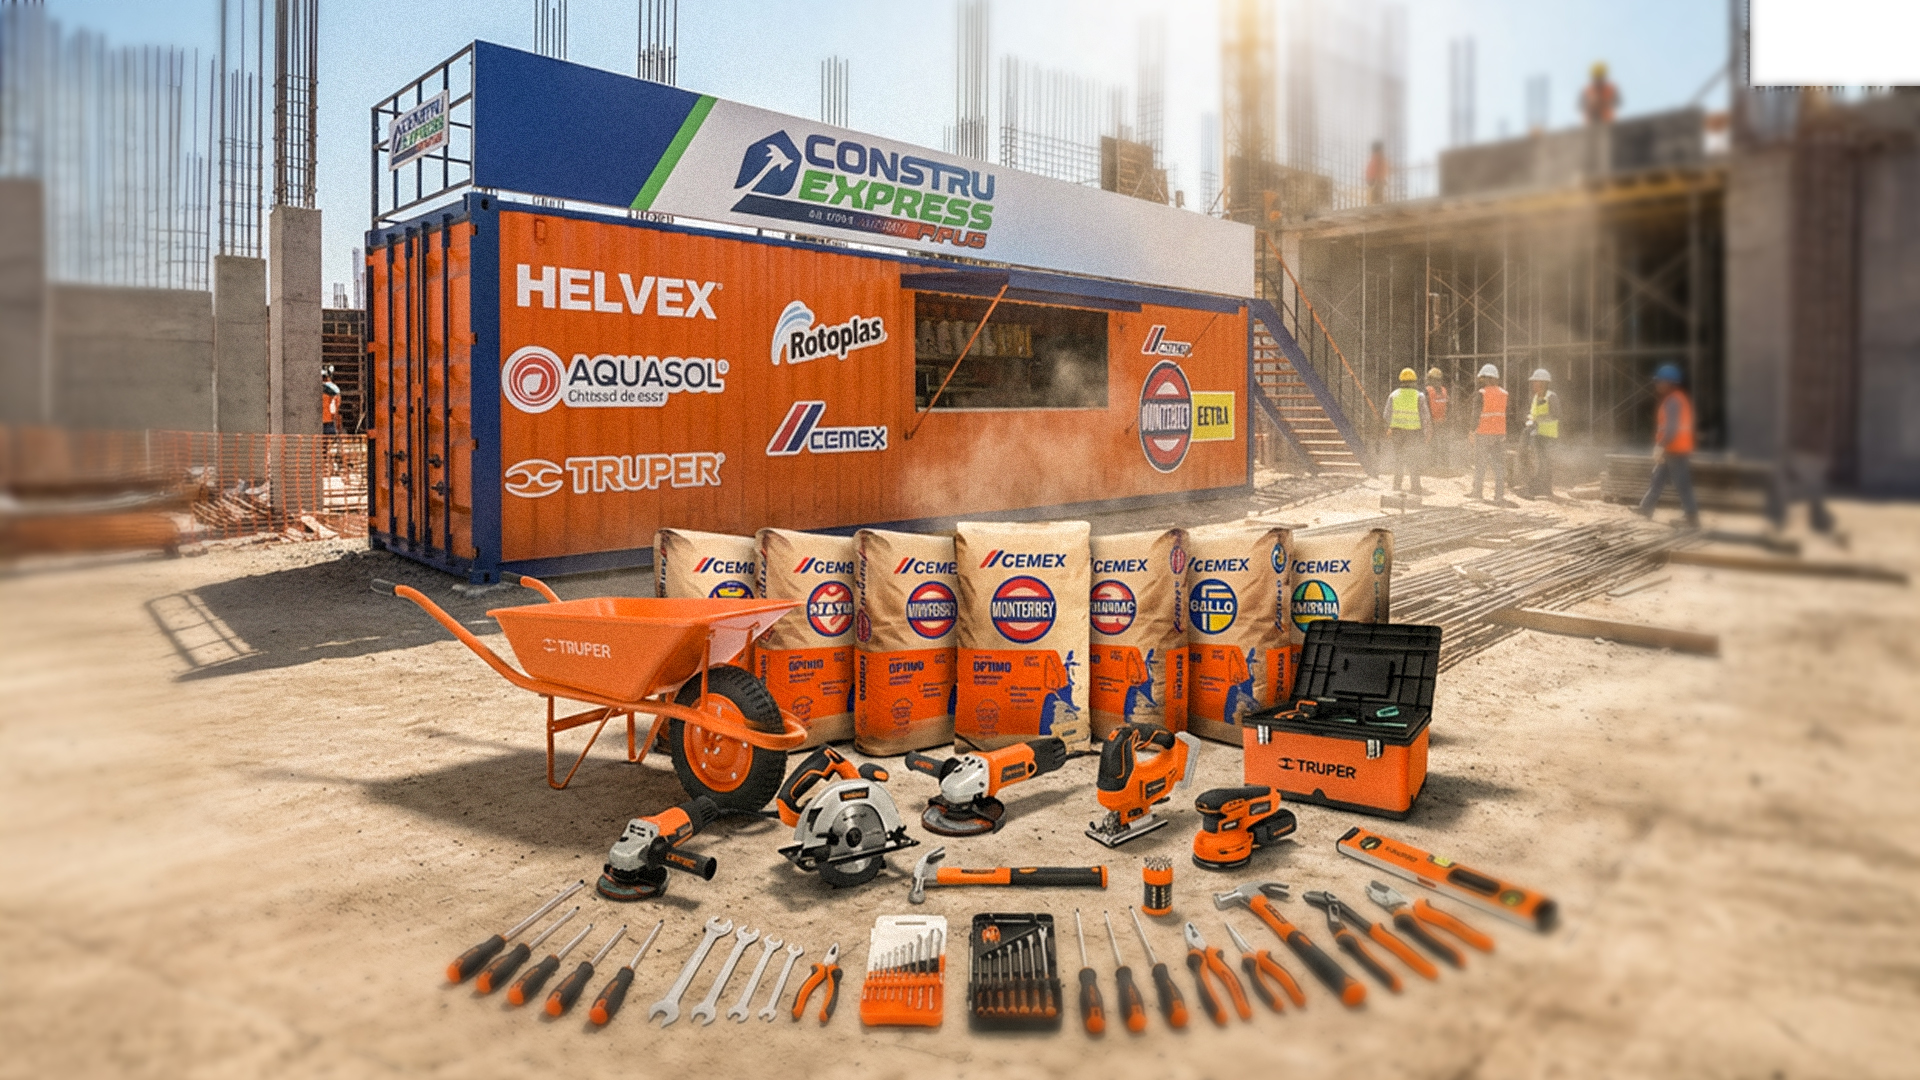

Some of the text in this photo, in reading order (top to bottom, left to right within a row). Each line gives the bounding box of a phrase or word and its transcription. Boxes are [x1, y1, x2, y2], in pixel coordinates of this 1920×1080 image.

[804, 134, 995, 201] CONSTRU
[798, 169, 994, 231] EXPRESS
[516, 263, 718, 320] HELVEX
[790, 318, 882, 359] Rotoplas
[568, 358, 722, 389] AQUASOL
[620, 389, 636, 403] de
[810, 430, 885, 449] CEMEX
[565, 453, 721, 494] TRUPER
[1001, 553, 1067, 568] CEMEX
[1093, 558, 1148, 573] CEMEX
[1194, 557, 1250, 572] CEMEX
[1295, 559, 1351, 574] CEMEX
[558, 639, 612, 659] TRUPER
[1296, 759, 1357, 779] TRUPER
